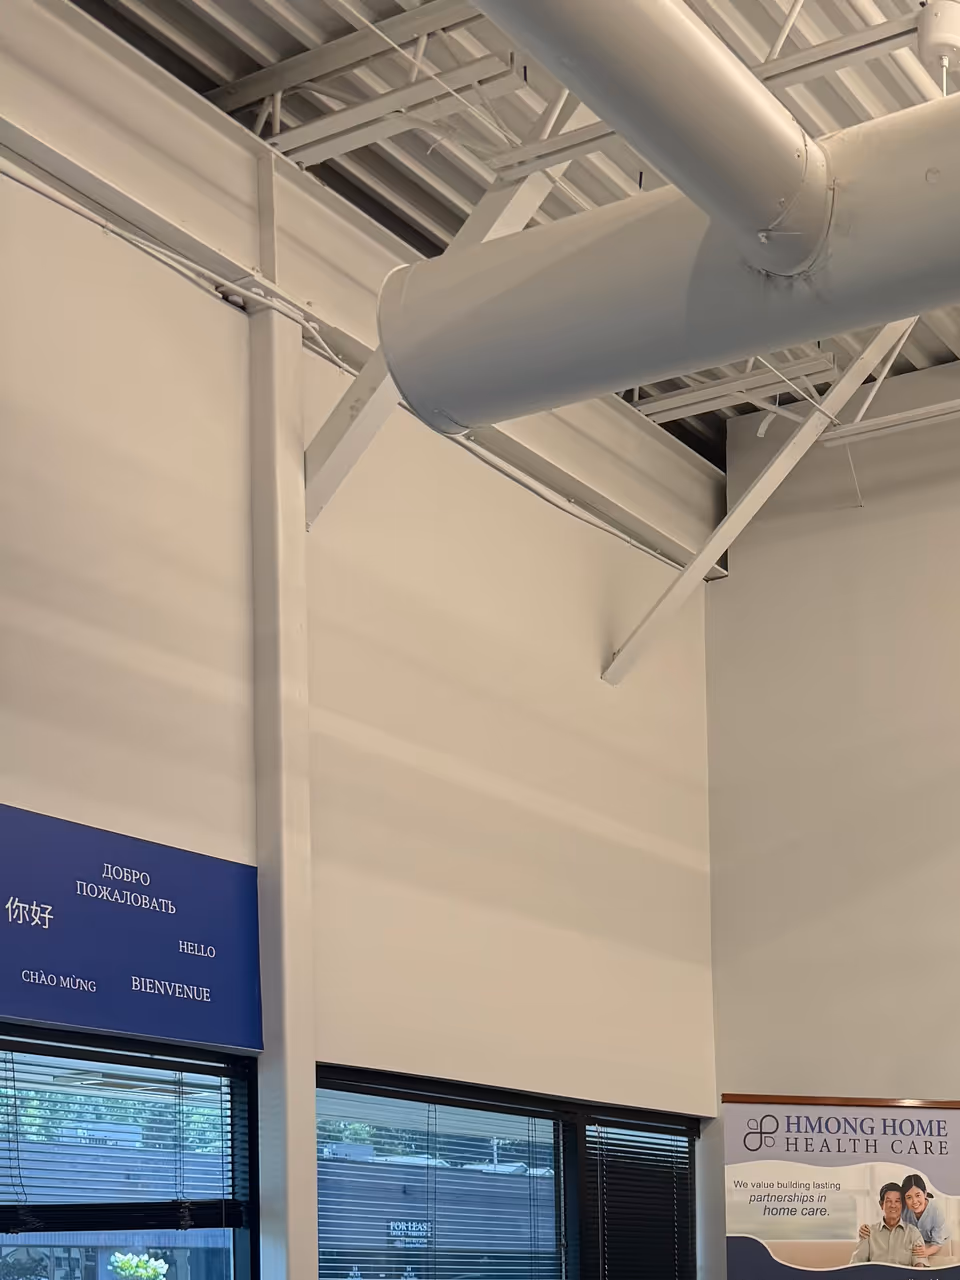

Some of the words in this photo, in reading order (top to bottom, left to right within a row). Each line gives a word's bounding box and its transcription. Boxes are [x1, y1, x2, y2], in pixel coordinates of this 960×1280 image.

[102, 863, 150, 886] ДОБРО
[76, 881, 175, 914] ПОЖАЛОВАТЬ
[5, 897, 53, 928] 你好
[179, 940, 216, 957] HELLO
[22, 970, 57, 986] CHÀO
[131, 976, 210, 1001] BIENVENUE
[785, 1115, 875, 1136] HMONG
[881, 1118, 948, 1137] HOME
[785, 1138, 878, 1153] HEALTH
[891, 1140, 949, 1155] CARE
[751, 1181, 774, 1189] value
[777, 1181, 810, 1190] building
[813, 1181, 841, 1191] lasting
[749, 1193, 814, 1204] partnerships
[818, 1194, 826, 1202] in
[763, 1205, 797, 1216] home
[801, 1207, 830, 1216] care.
